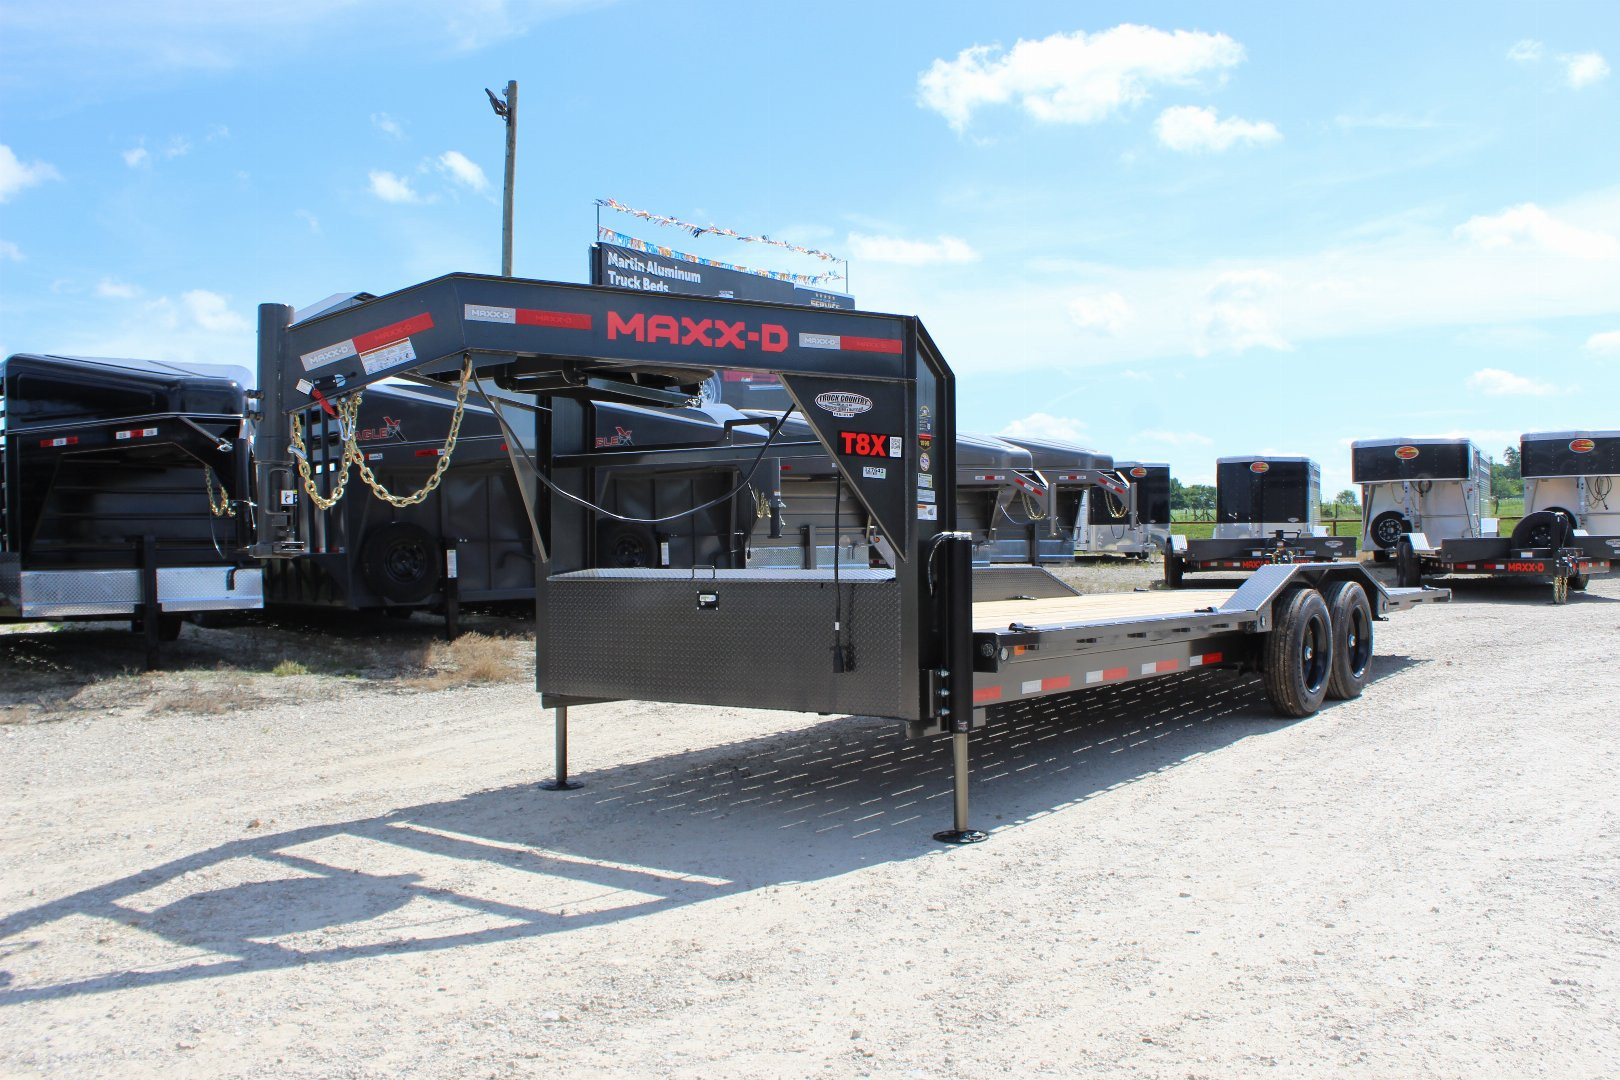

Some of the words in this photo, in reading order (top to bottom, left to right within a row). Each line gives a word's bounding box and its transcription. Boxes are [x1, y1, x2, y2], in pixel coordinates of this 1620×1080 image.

[607, 251, 645, 273] Martin
[647, 261, 702, 284] Aluminum
[607, 270, 641, 290] Truck
[643, 277, 669, 292] Beds
[471, 308, 509, 319] MAXX-D
[607, 311, 789, 353] MAXX-D
[804, 336, 835, 346] MAXX-D
[308, 345, 349, 365] MAXX-D
[819, 393, 840, 403] TRUCK
[841, 432, 887, 457] T8X
[1507, 562, 1545, 573] MAXX-D
